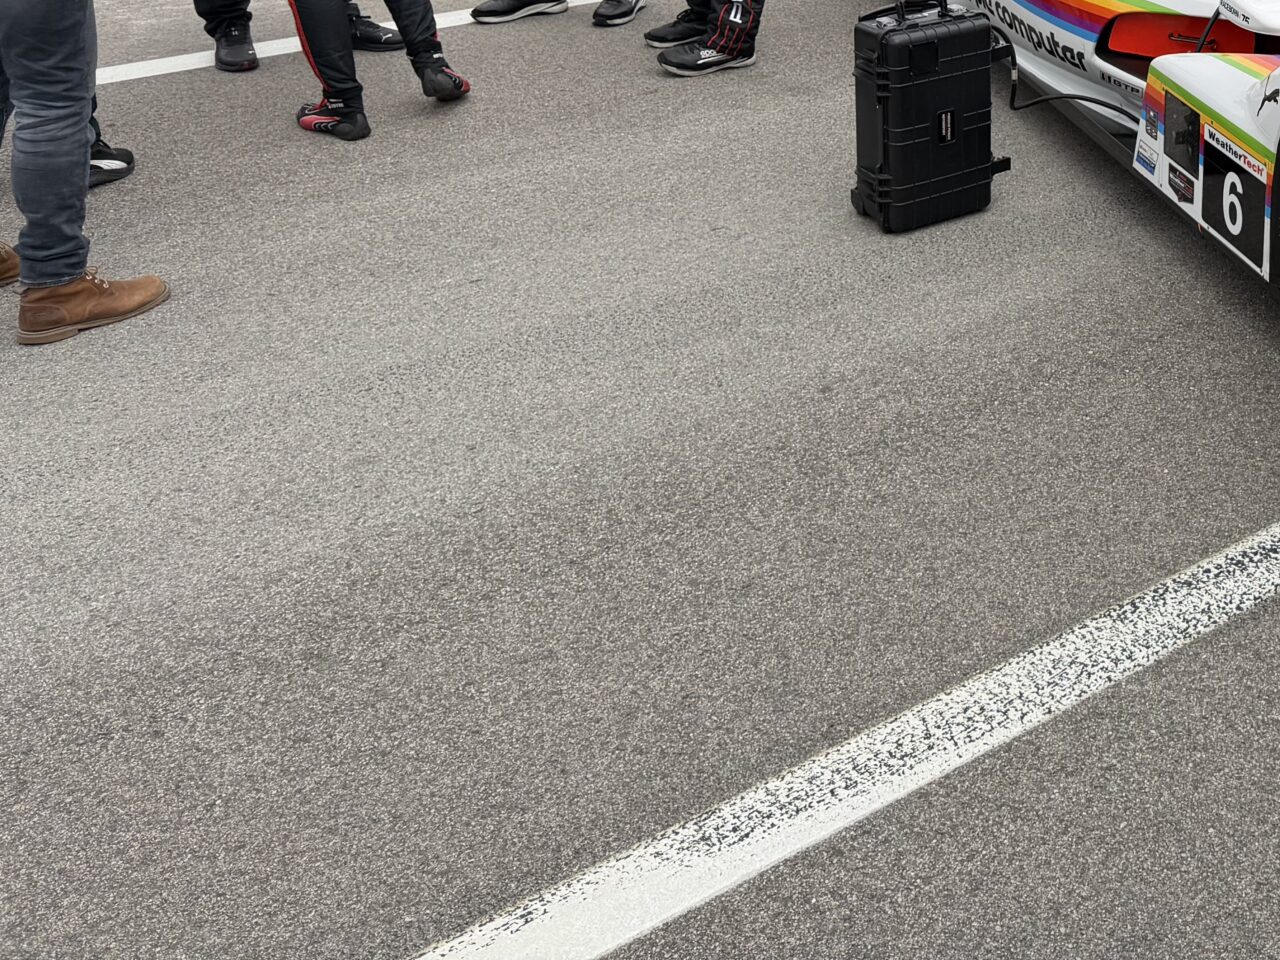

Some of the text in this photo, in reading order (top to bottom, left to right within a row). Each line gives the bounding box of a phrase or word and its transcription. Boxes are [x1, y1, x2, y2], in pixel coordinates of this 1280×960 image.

[994, 0, 1088, 72] computer
[1207, 128, 1265, 177] WeatherTech
[1222, 171, 1244, 236] 6
